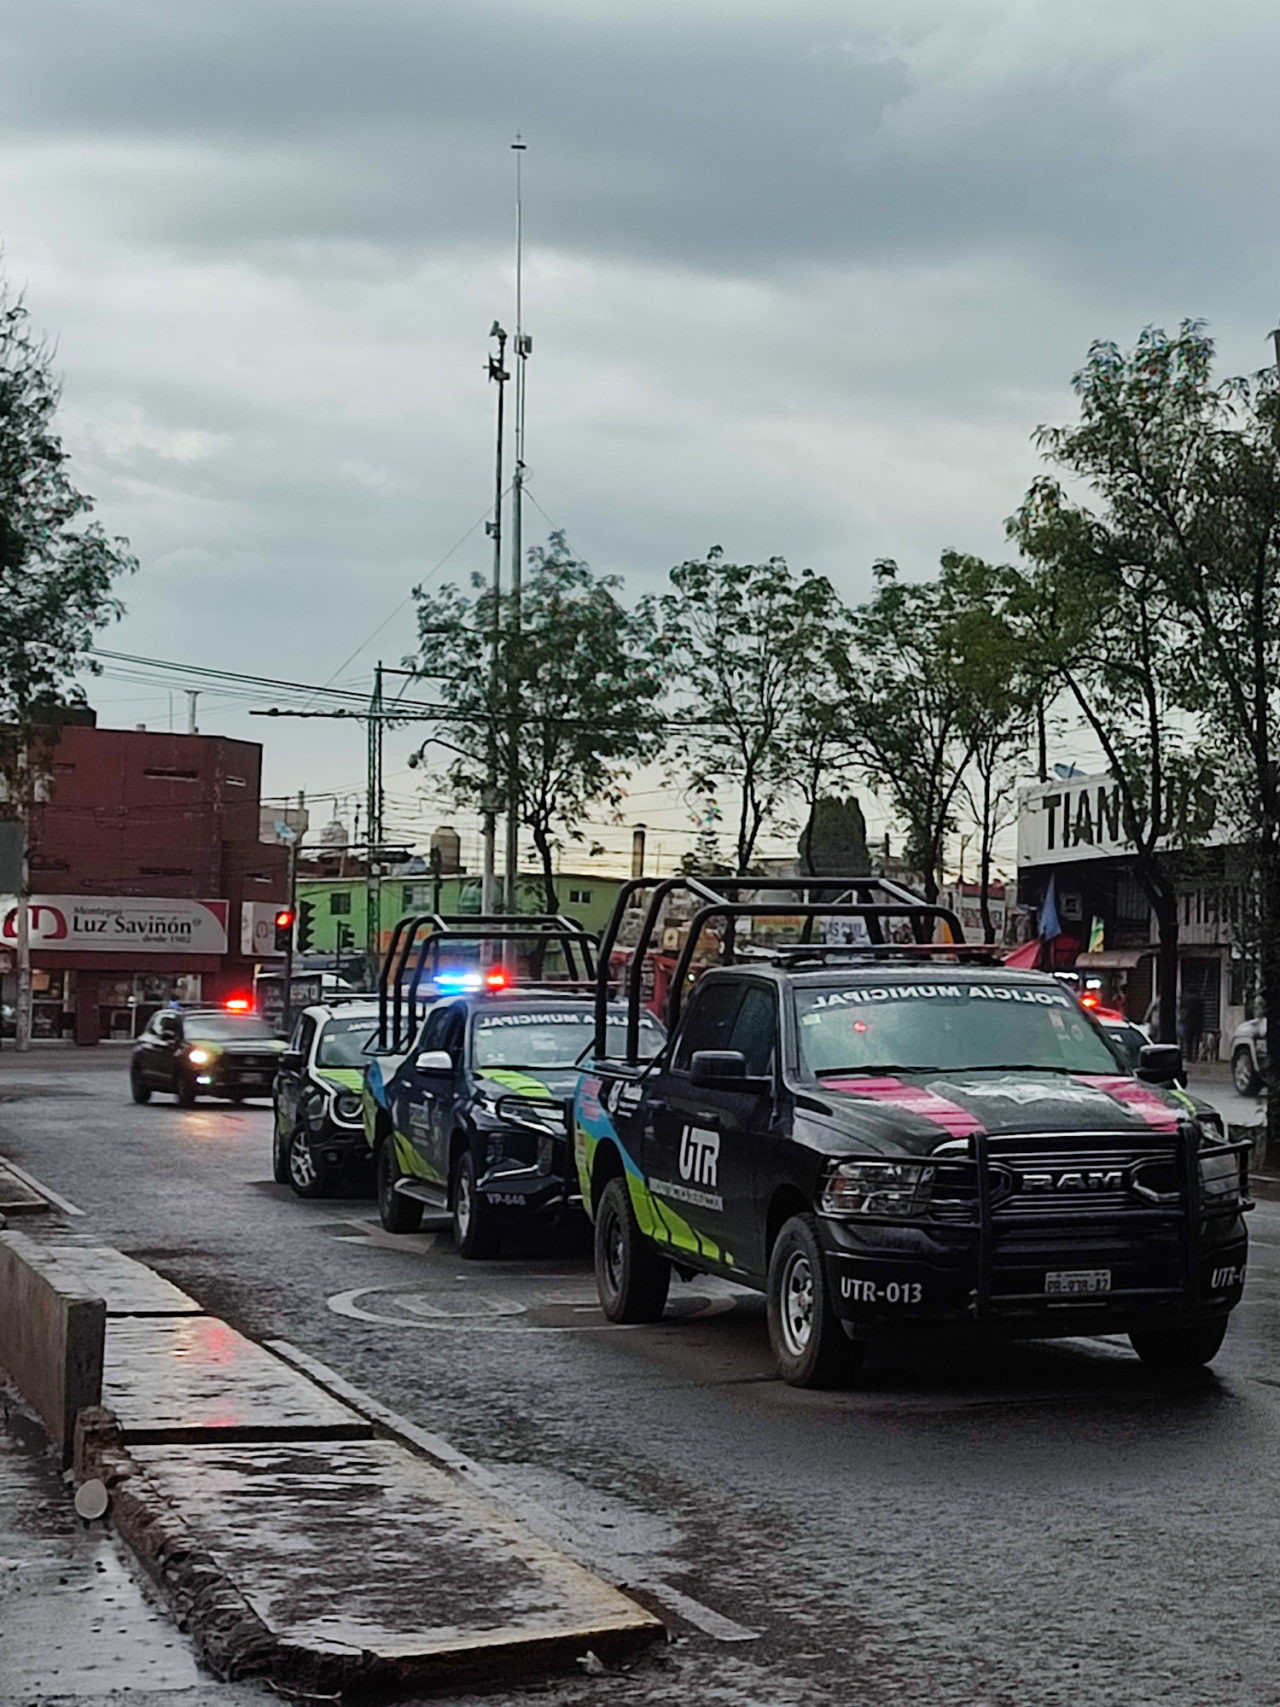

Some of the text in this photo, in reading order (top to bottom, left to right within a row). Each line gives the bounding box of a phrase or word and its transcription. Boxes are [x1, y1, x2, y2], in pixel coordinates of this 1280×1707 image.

[73, 915, 192, 935] Luz Saviñón
[679, 1125, 720, 1188] UTR
[1022, 1171, 1123, 1192] RAM
[840, 1275, 922, 1304] UTR-013
